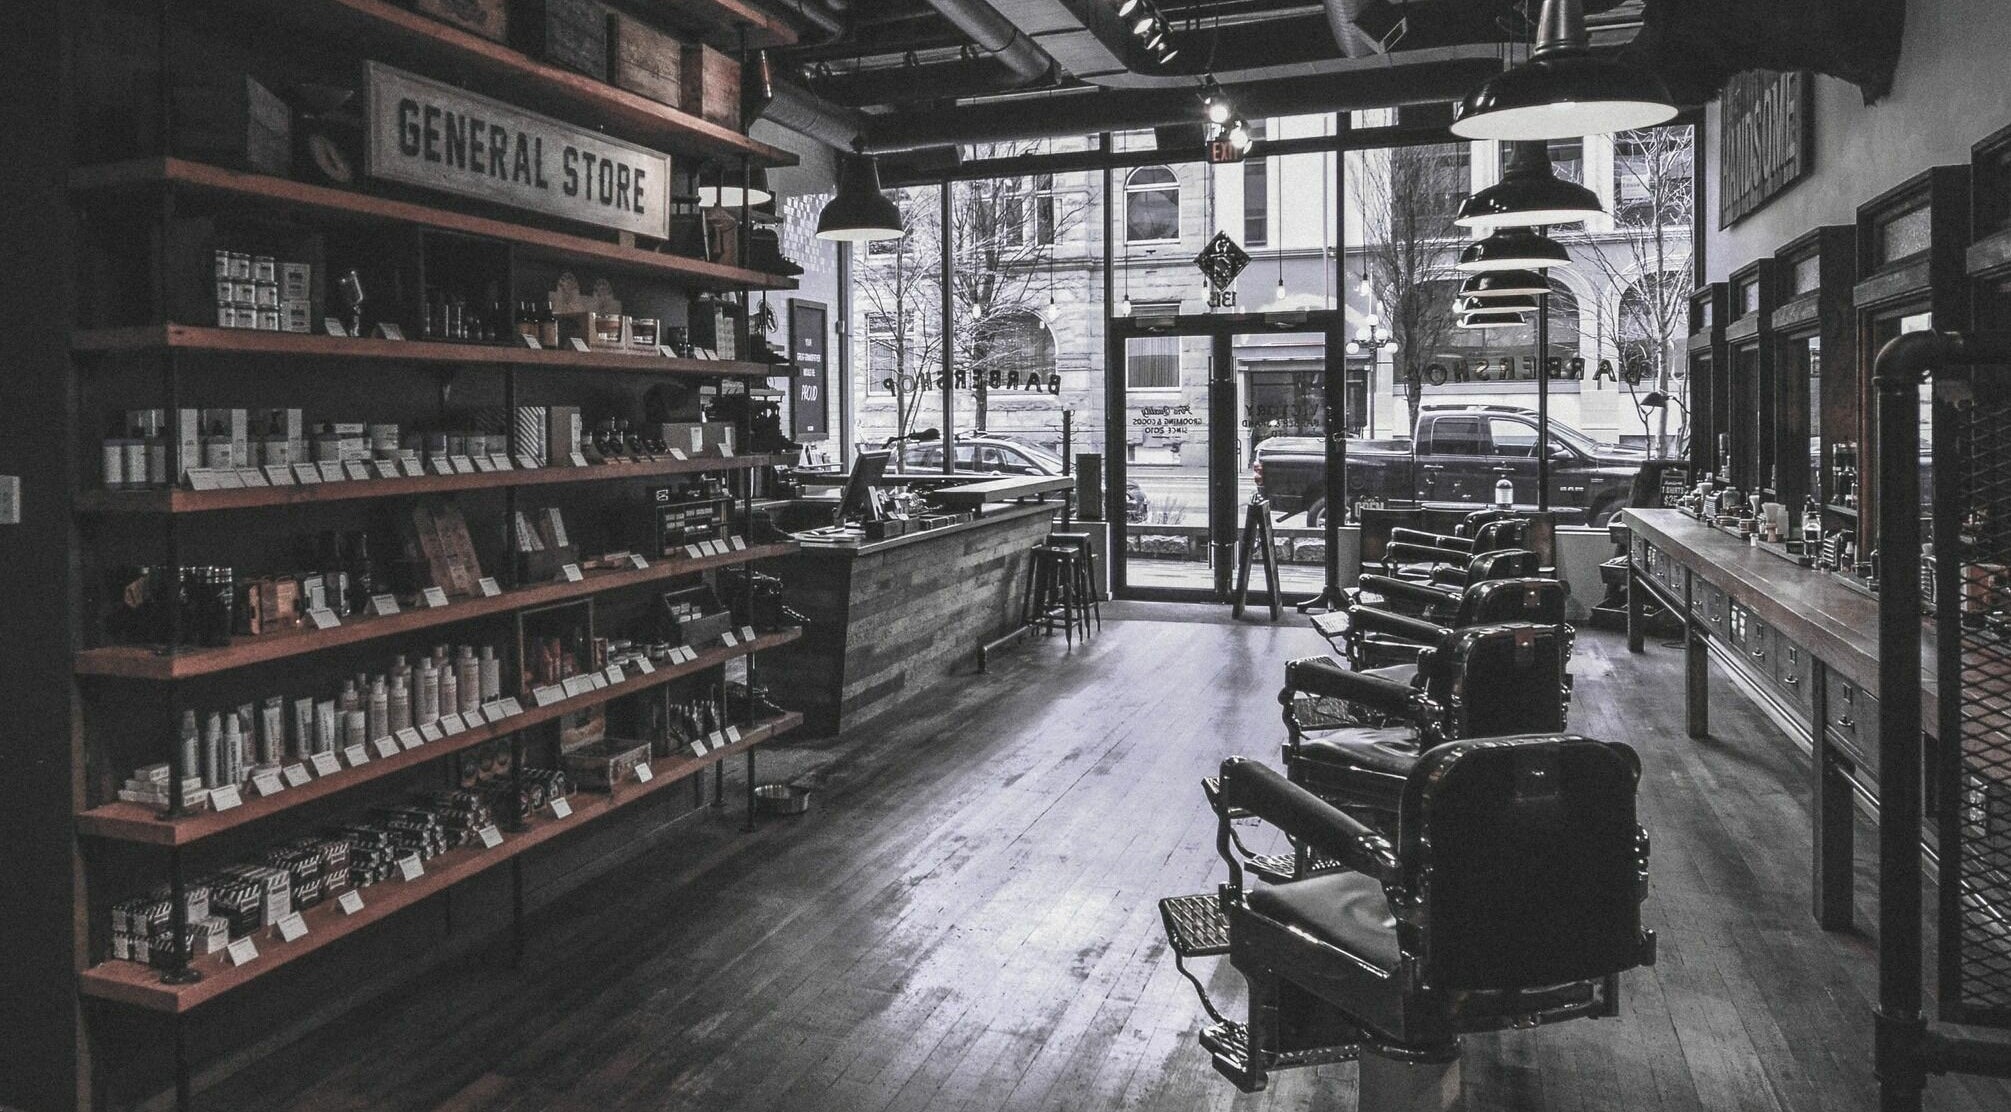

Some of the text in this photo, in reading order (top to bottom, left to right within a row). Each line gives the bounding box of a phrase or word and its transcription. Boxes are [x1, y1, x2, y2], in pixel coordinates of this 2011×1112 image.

[398, 97, 646, 214] GENERAL STORE
[1212, 141, 1240, 162] EXIT
[801, 385, 818, 401] PROUD
